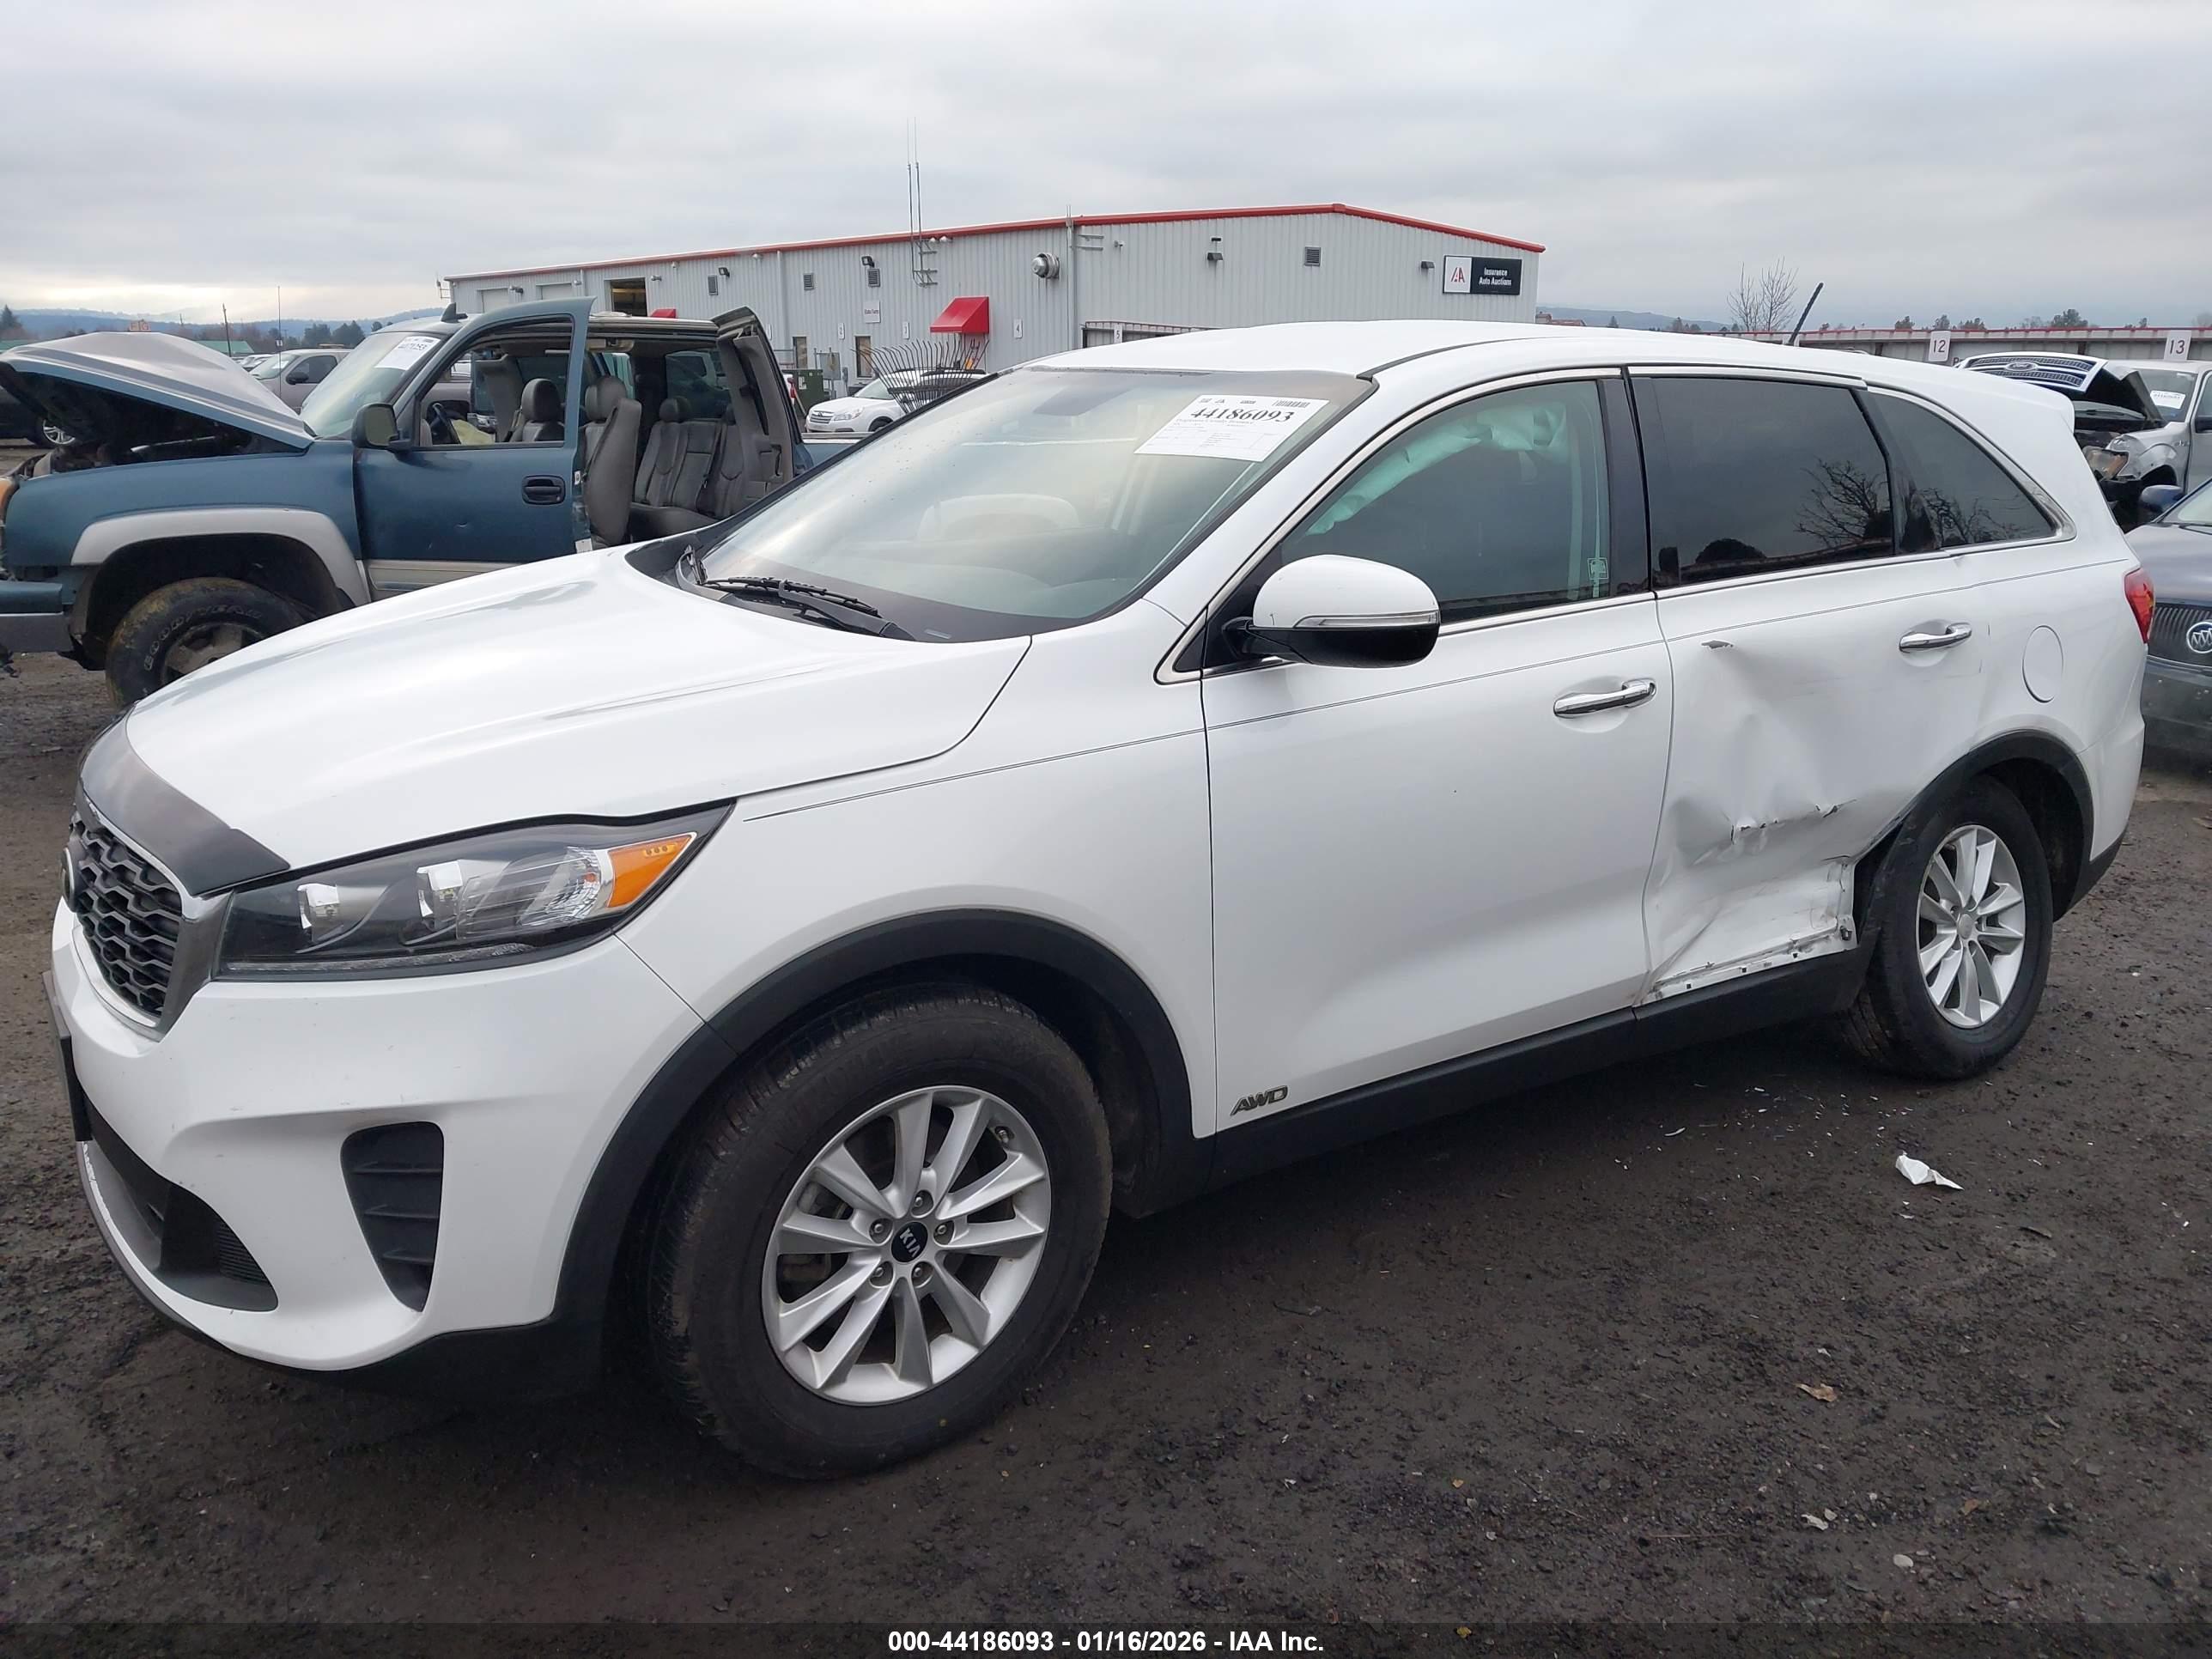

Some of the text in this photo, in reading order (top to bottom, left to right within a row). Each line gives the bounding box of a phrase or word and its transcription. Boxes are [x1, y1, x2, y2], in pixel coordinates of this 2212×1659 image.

[1484, 267, 1508, 276] Insurance
[1479, 276, 1512, 286] Auto Auctions
[1933, 339, 1947, 353] 12
[2170, 339, 2185, 355] 13
[1190, 407, 1295, 423] 44186093
[1229, 1085, 1289, 1117] AWD
[899, 1227, 921, 1258] KIA
